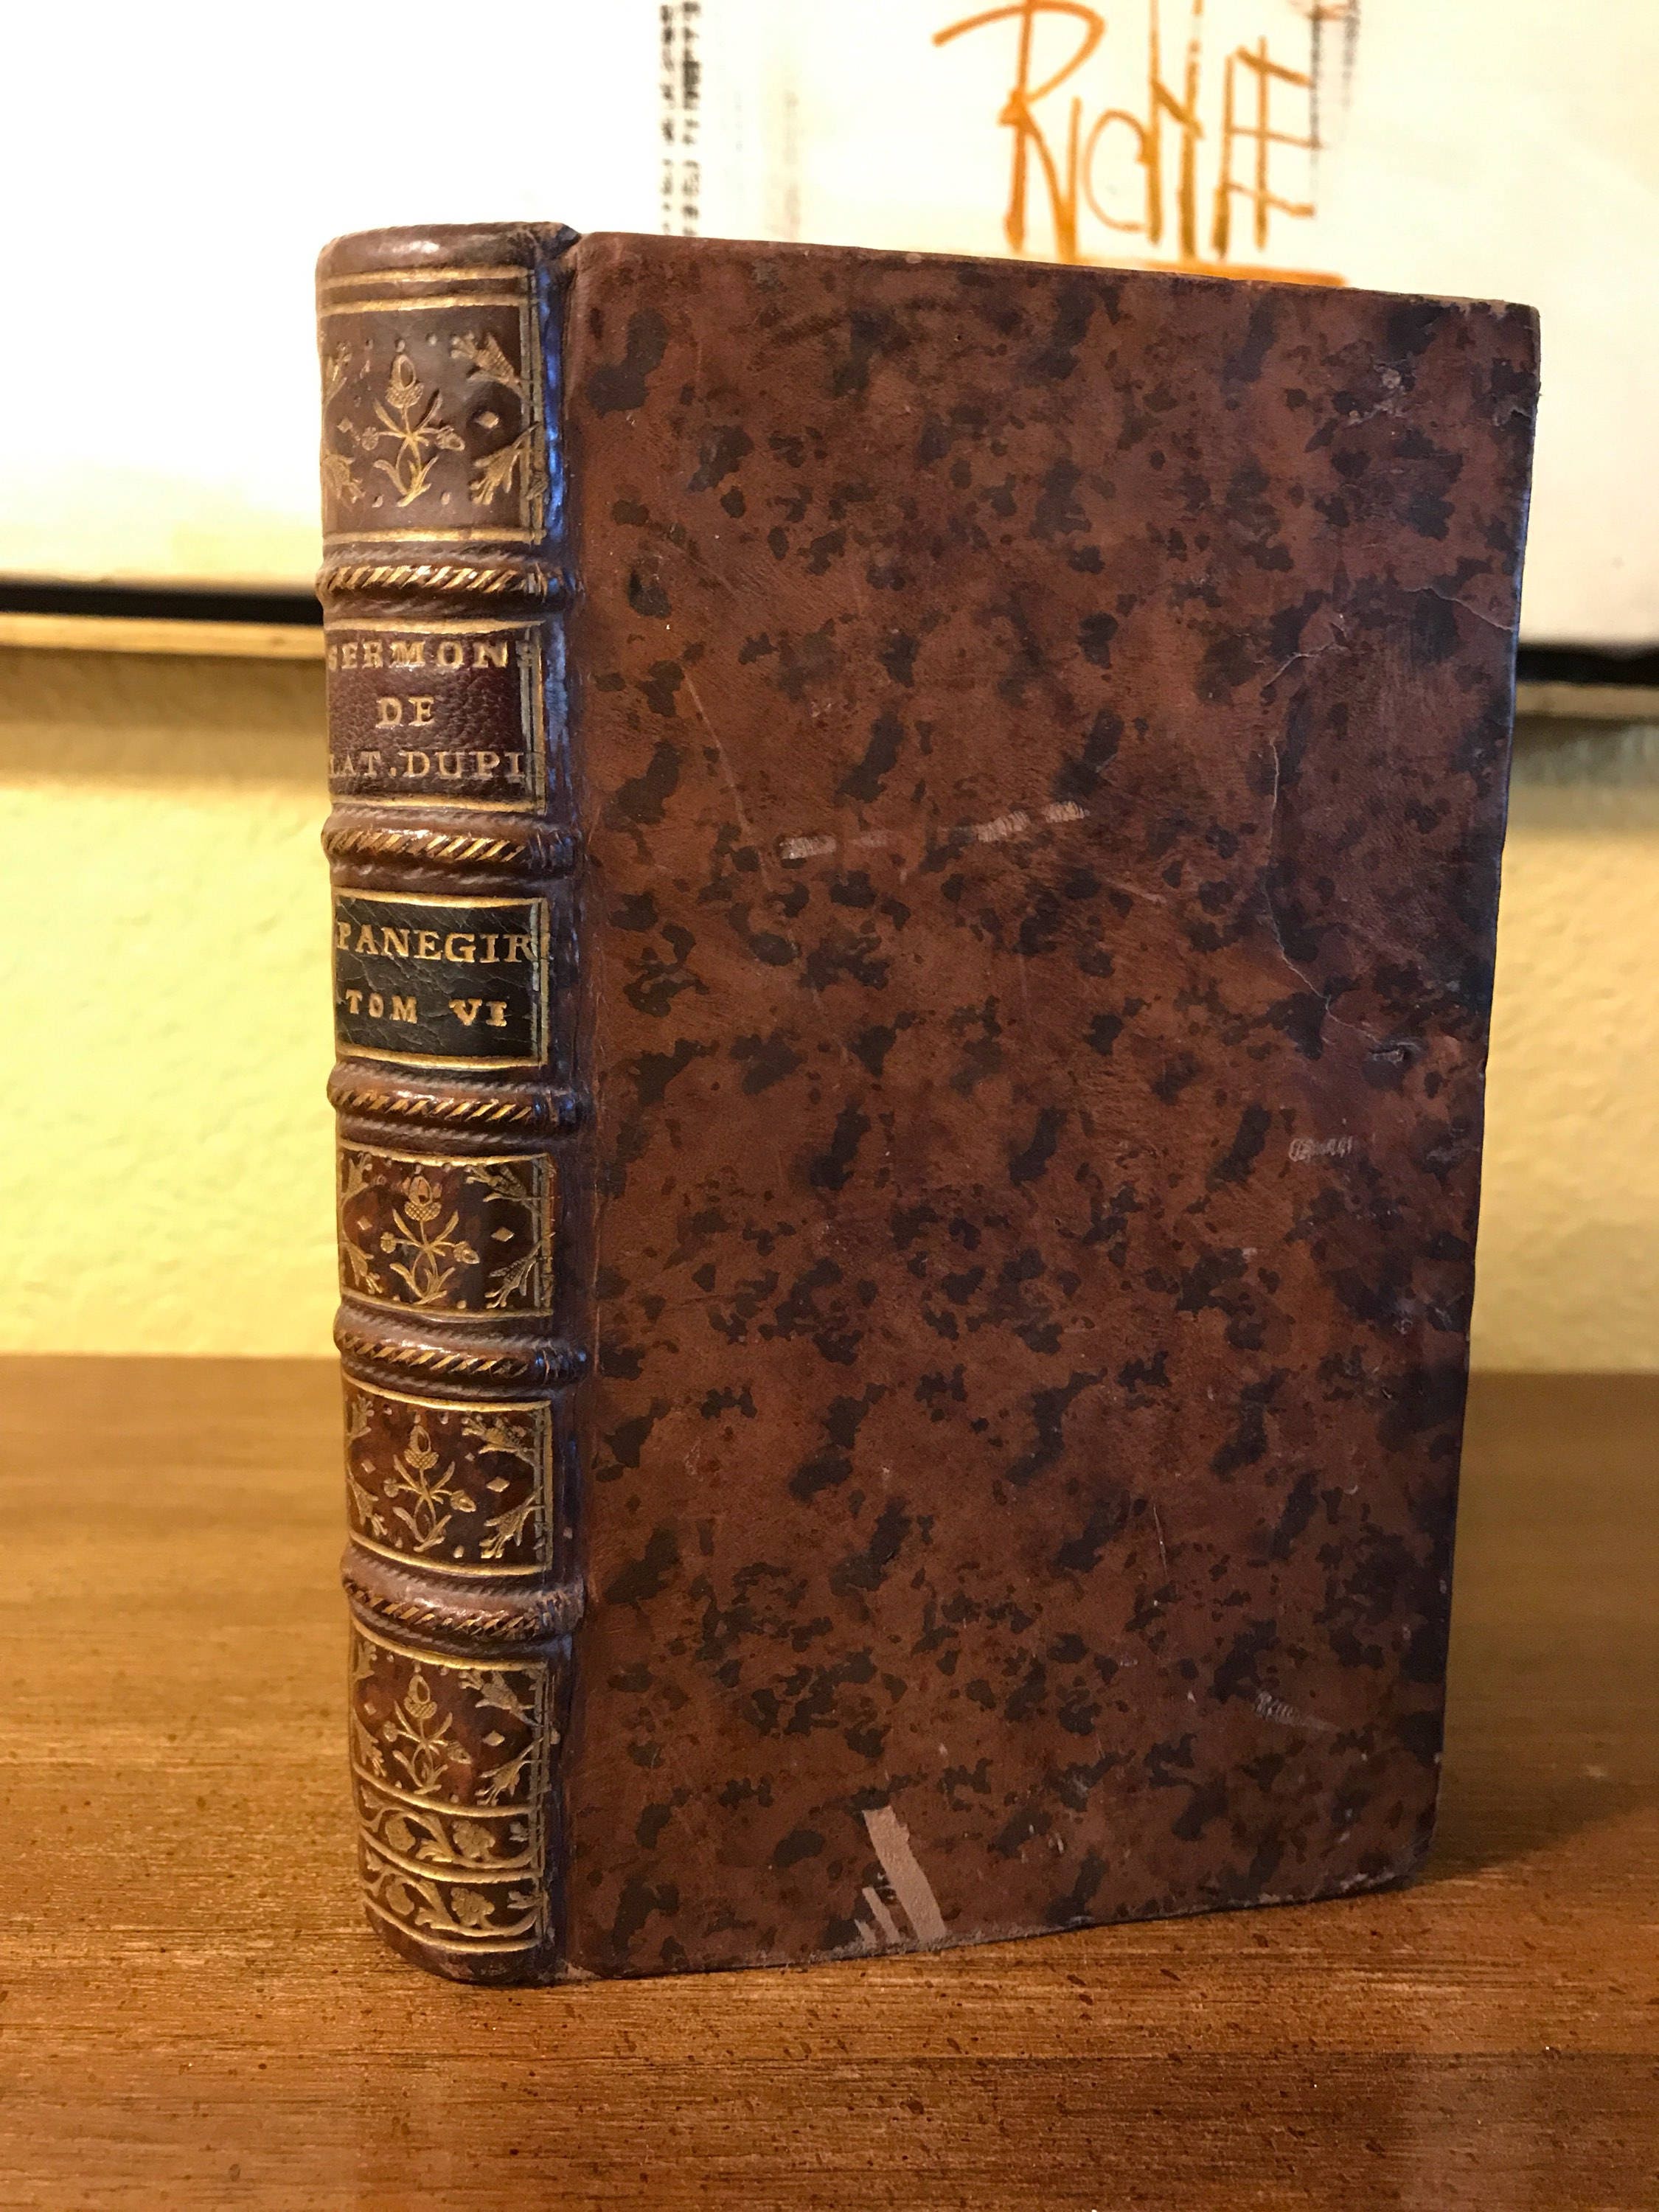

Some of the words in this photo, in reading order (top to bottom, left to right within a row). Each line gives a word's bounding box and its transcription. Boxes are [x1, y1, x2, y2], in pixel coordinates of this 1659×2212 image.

[376, 696, 435, 728] DE
[346, 989, 418, 1024] TOM
[449, 998, 507, 1027] VI
